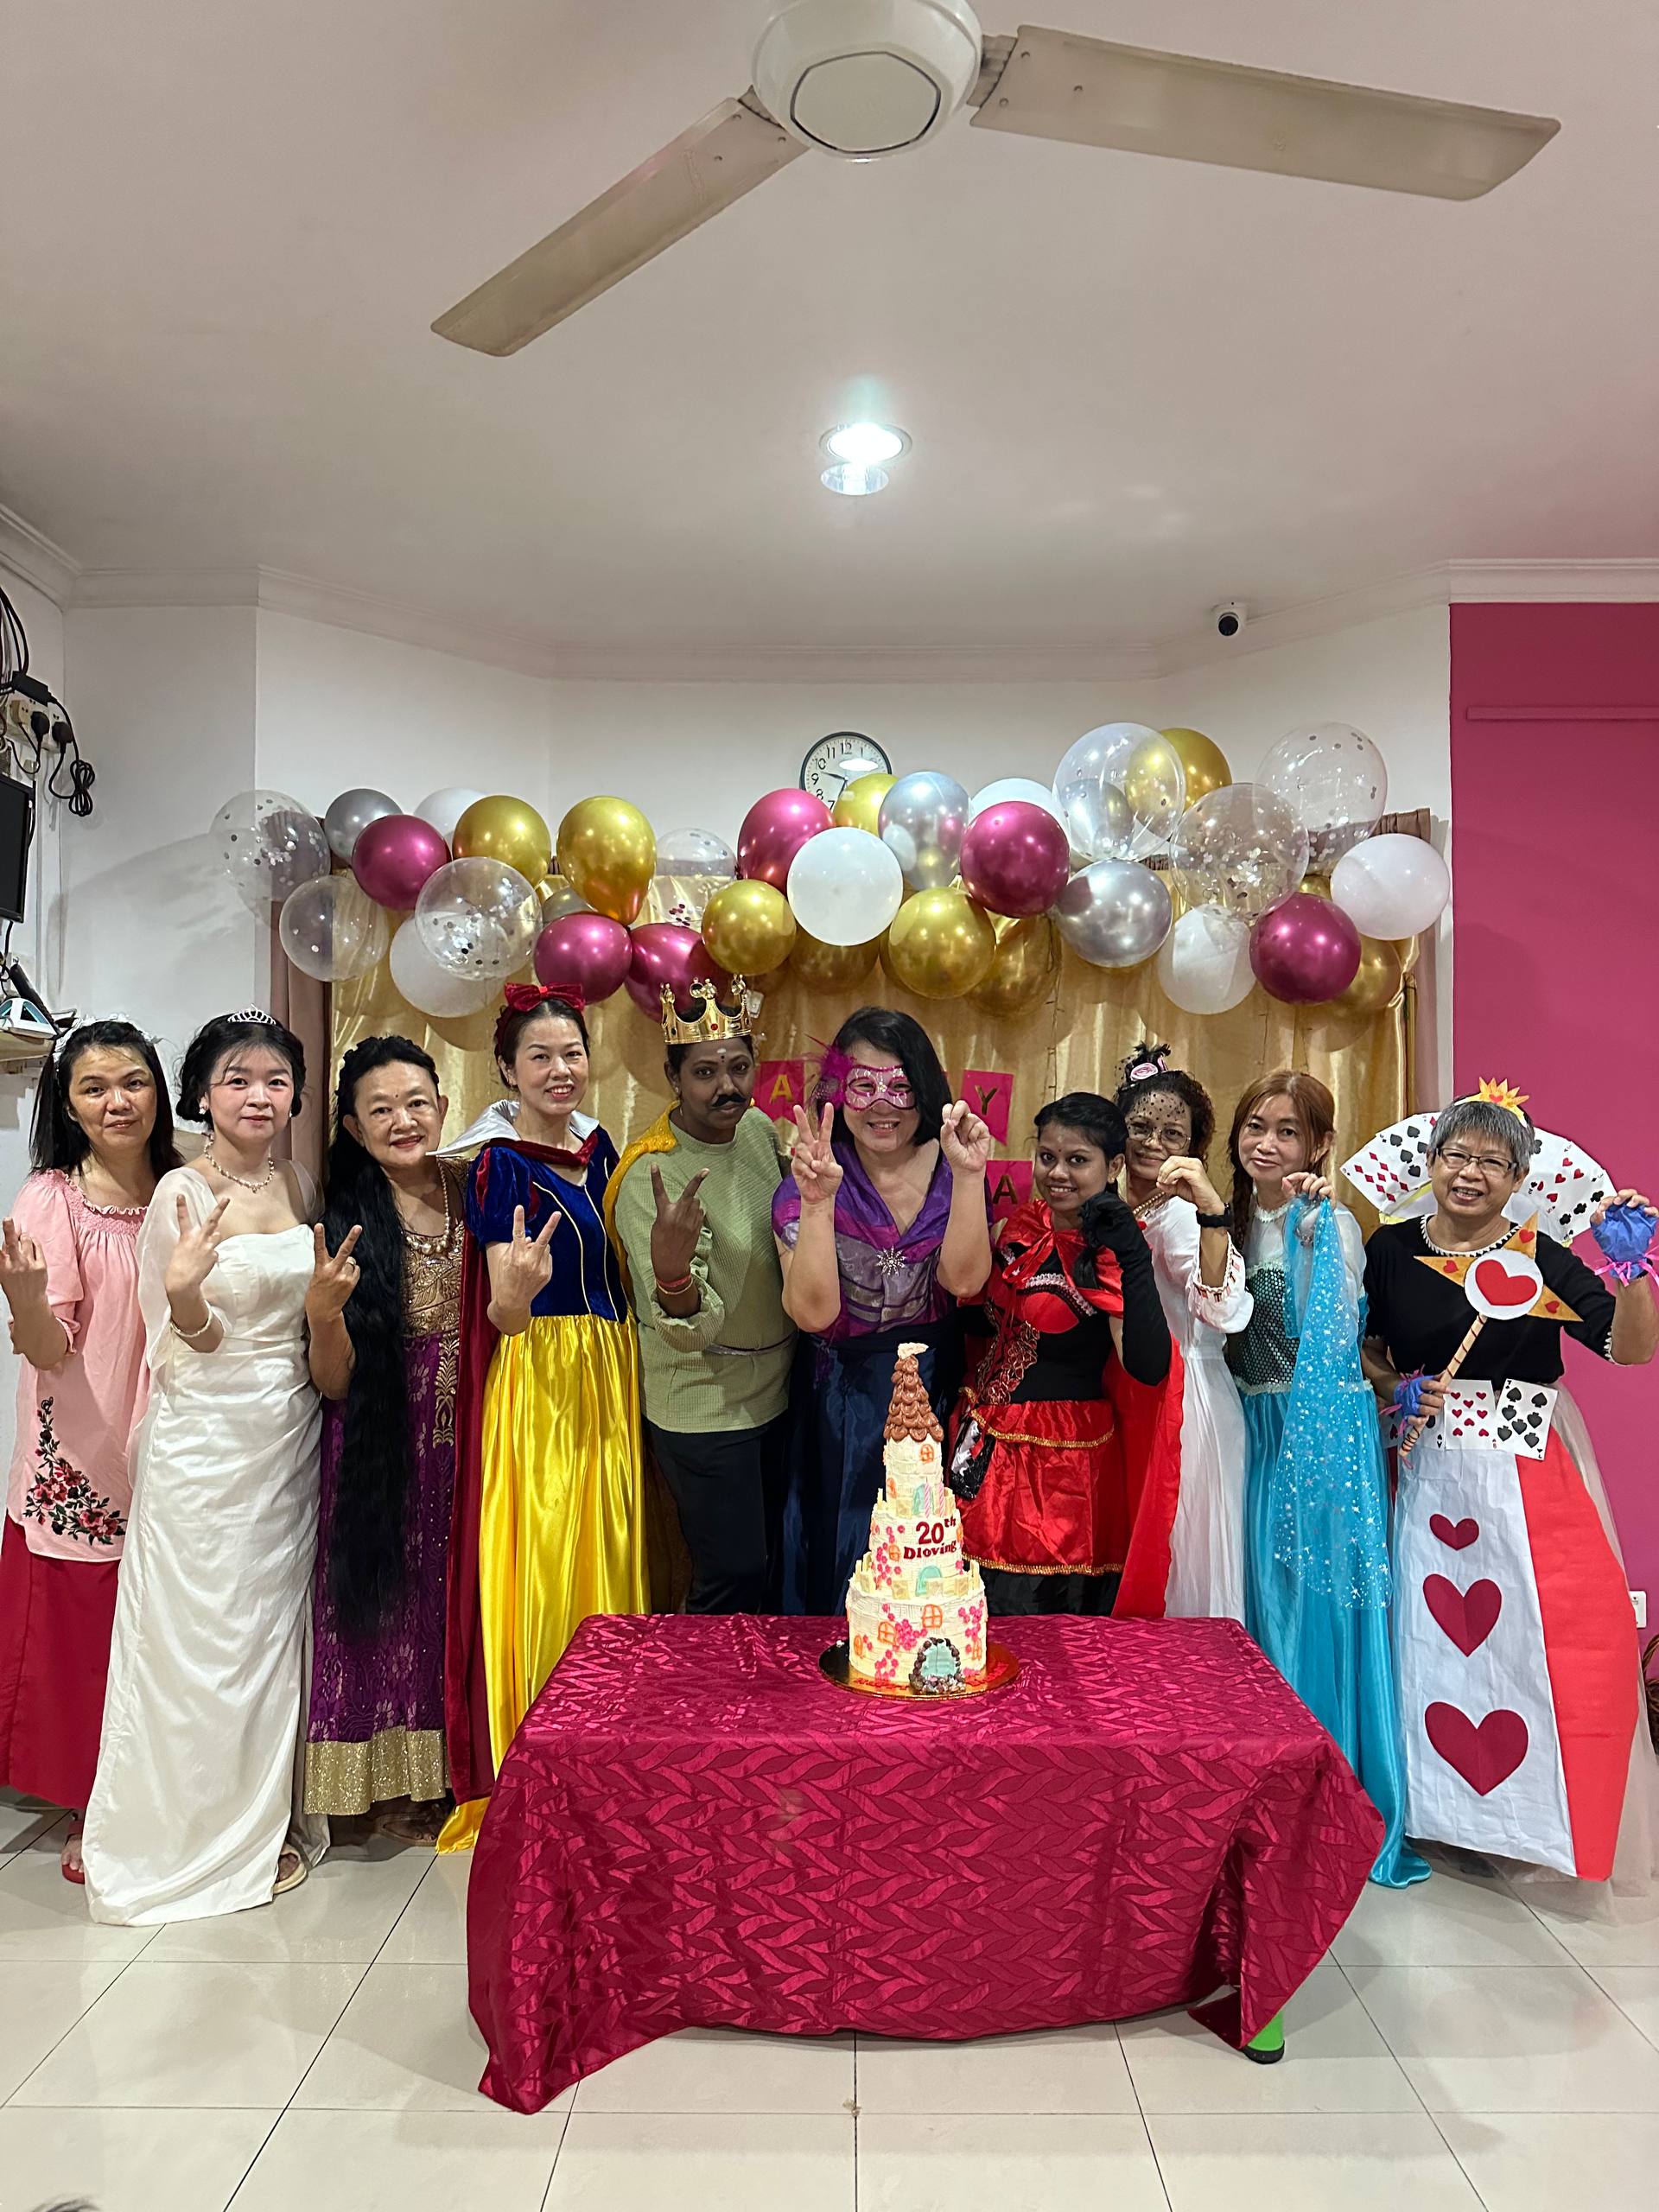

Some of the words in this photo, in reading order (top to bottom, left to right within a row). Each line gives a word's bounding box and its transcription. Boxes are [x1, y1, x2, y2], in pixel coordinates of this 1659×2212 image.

[826, 745, 836, 759] 11
[841, 742, 852, 754] 12
[815, 758, 826, 770] 10
[811, 773, 819, 785] 9
[817, 788, 823, 800] 8
[827, 800, 836, 810] 7
[770, 1074, 793, 1103] A
[974, 1084, 999, 1116] Y
[992, 1174, 1018, 1205] A
[916, 1516, 957, 1545] 20th
